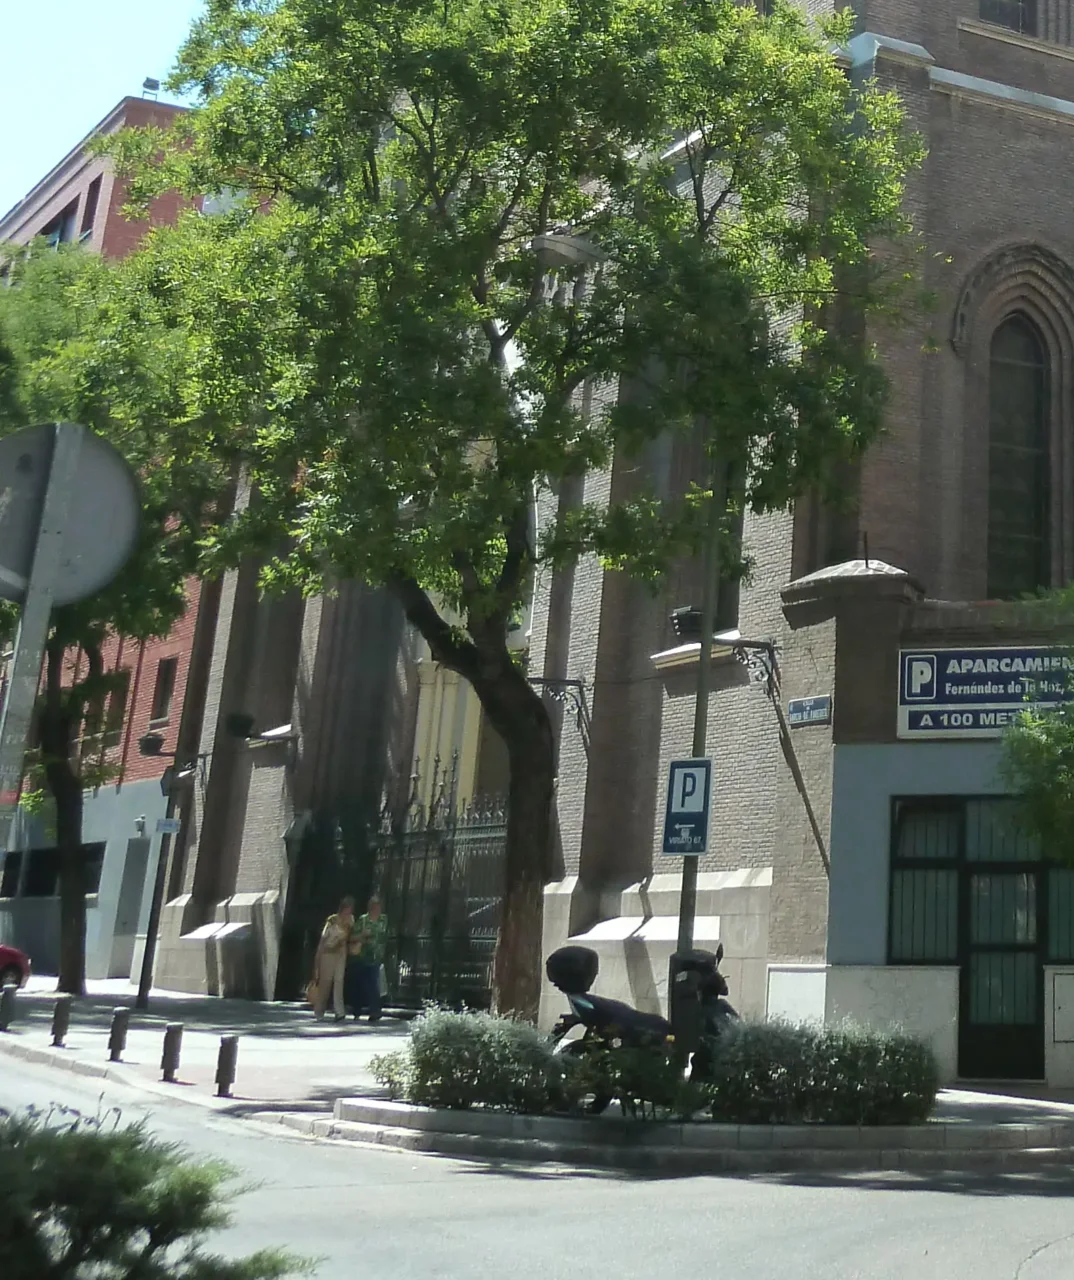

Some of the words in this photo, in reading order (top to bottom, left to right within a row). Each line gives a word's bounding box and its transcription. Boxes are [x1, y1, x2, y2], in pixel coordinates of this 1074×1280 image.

[911, 661, 932, 694] P
[945, 681, 1005, 695] Fernández
[1007, 680, 1022, 693] de
[920, 714, 934, 727] A
[939, 713, 974, 726] 100
[681, 773, 697, 808] P
